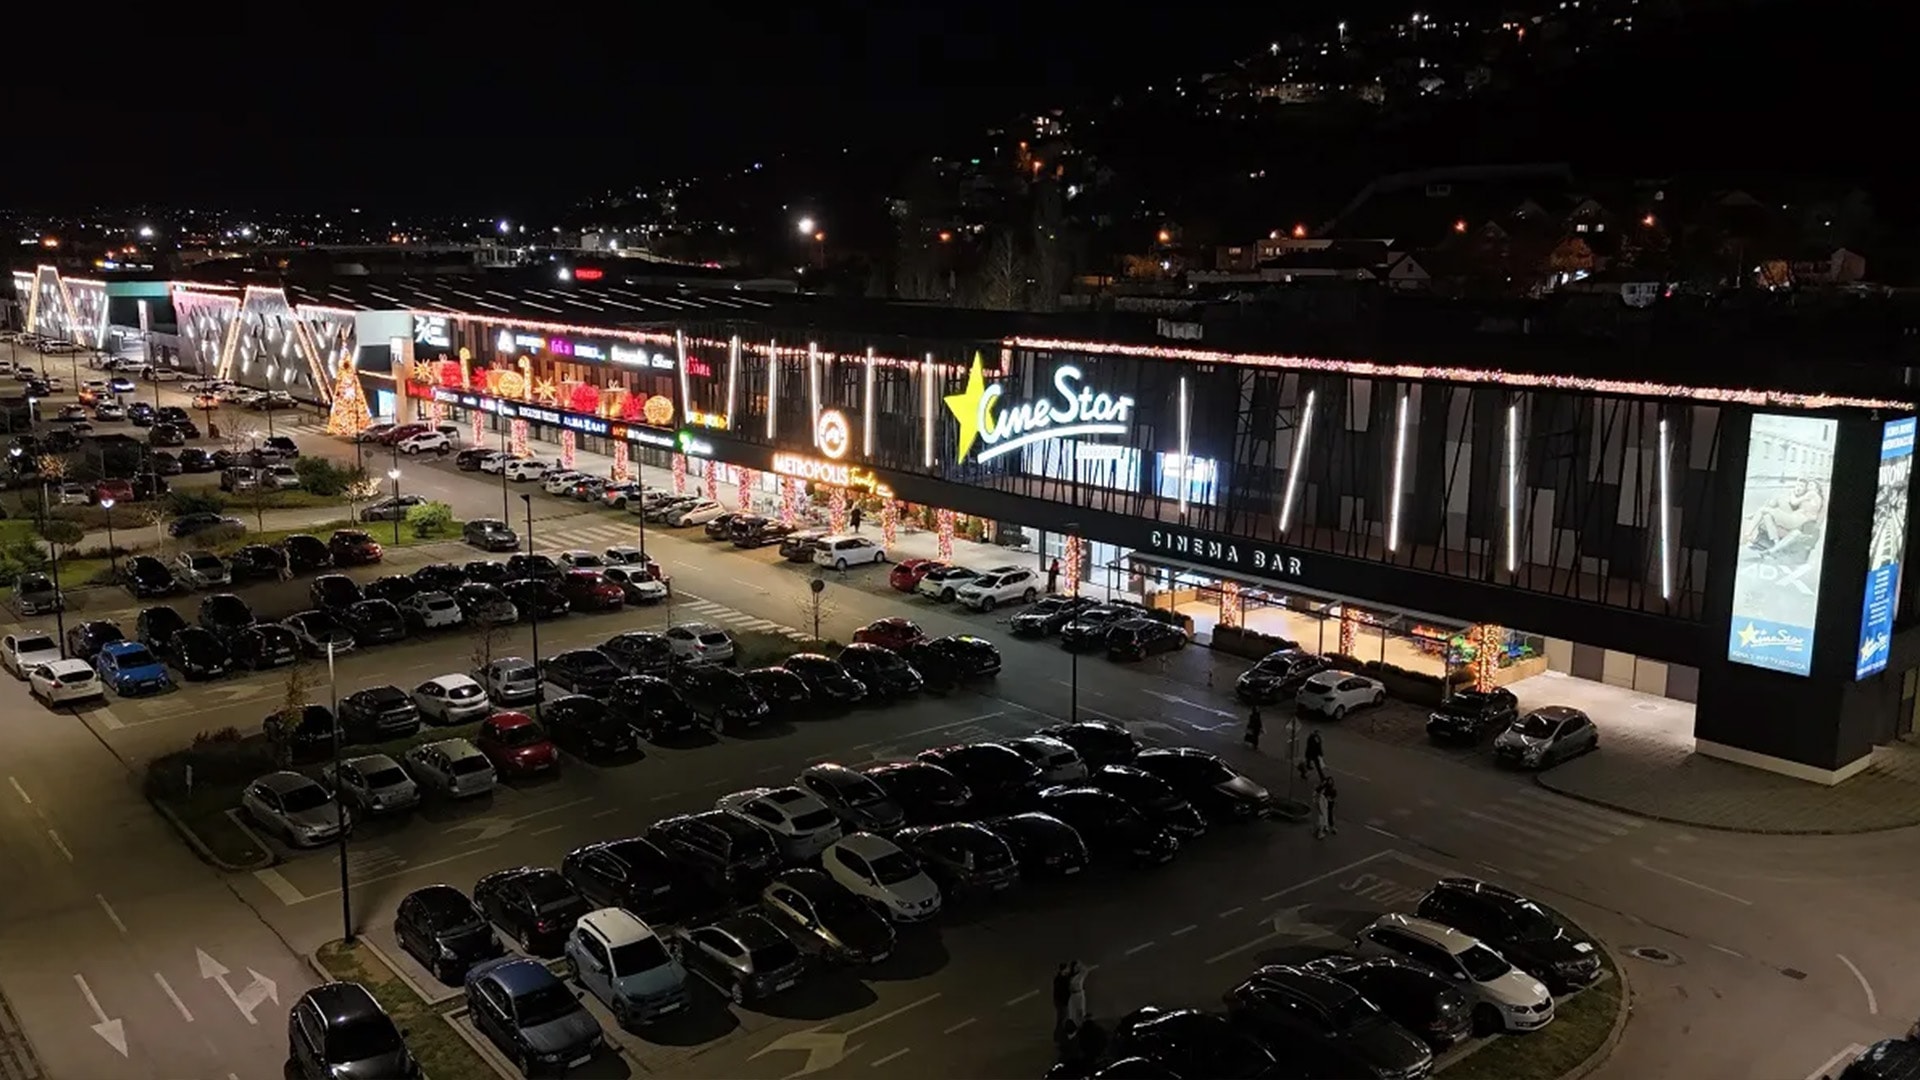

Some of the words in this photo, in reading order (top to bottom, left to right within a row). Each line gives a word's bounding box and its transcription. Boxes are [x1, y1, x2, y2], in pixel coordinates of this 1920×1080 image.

[977, 365, 1134, 443] CineStar
[773, 452, 849, 486] METROPOLIS
[1151, 530, 1239, 563] CINEMA
[1253, 550, 1302, 576] BAR
